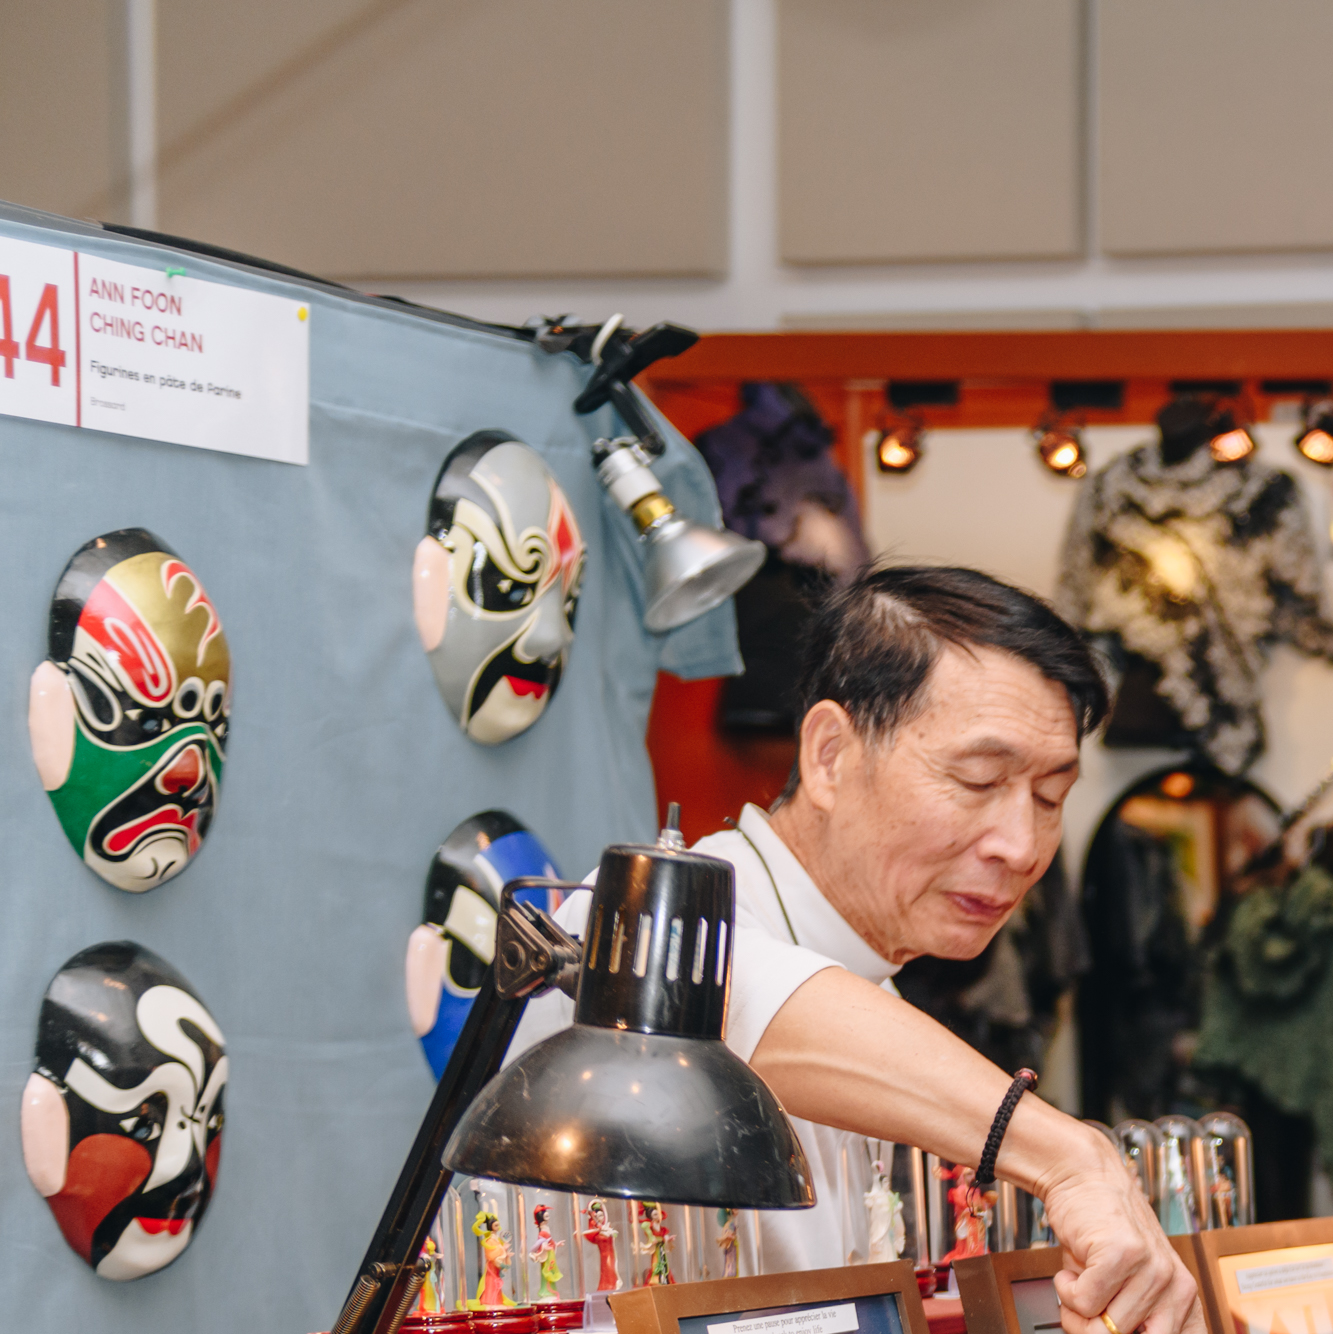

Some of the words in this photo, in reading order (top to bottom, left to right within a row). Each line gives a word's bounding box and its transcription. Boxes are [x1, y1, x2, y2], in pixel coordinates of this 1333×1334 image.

[89, 277, 124, 304] ANN
[131, 286, 182, 316] FOON
[0, 274, 65, 387] 44
[90, 312, 145, 343] CHING
[151, 325, 204, 353] CHAN
[90, 360, 140, 381] Figurines
[143, 373, 156, 384] en
[159, 375, 186, 390] pâte
[190, 380, 203, 392] de
[733, 1323, 752, 1334] Prenez
[753, 1322, 763, 1330] une
[765, 1320, 780, 1330] pause
[780, 1318, 794, 1329] pour
[821, 1311, 828, 1319] la
[828, 1309, 837, 1318] vie
[812, 1325, 823, 1334] life
